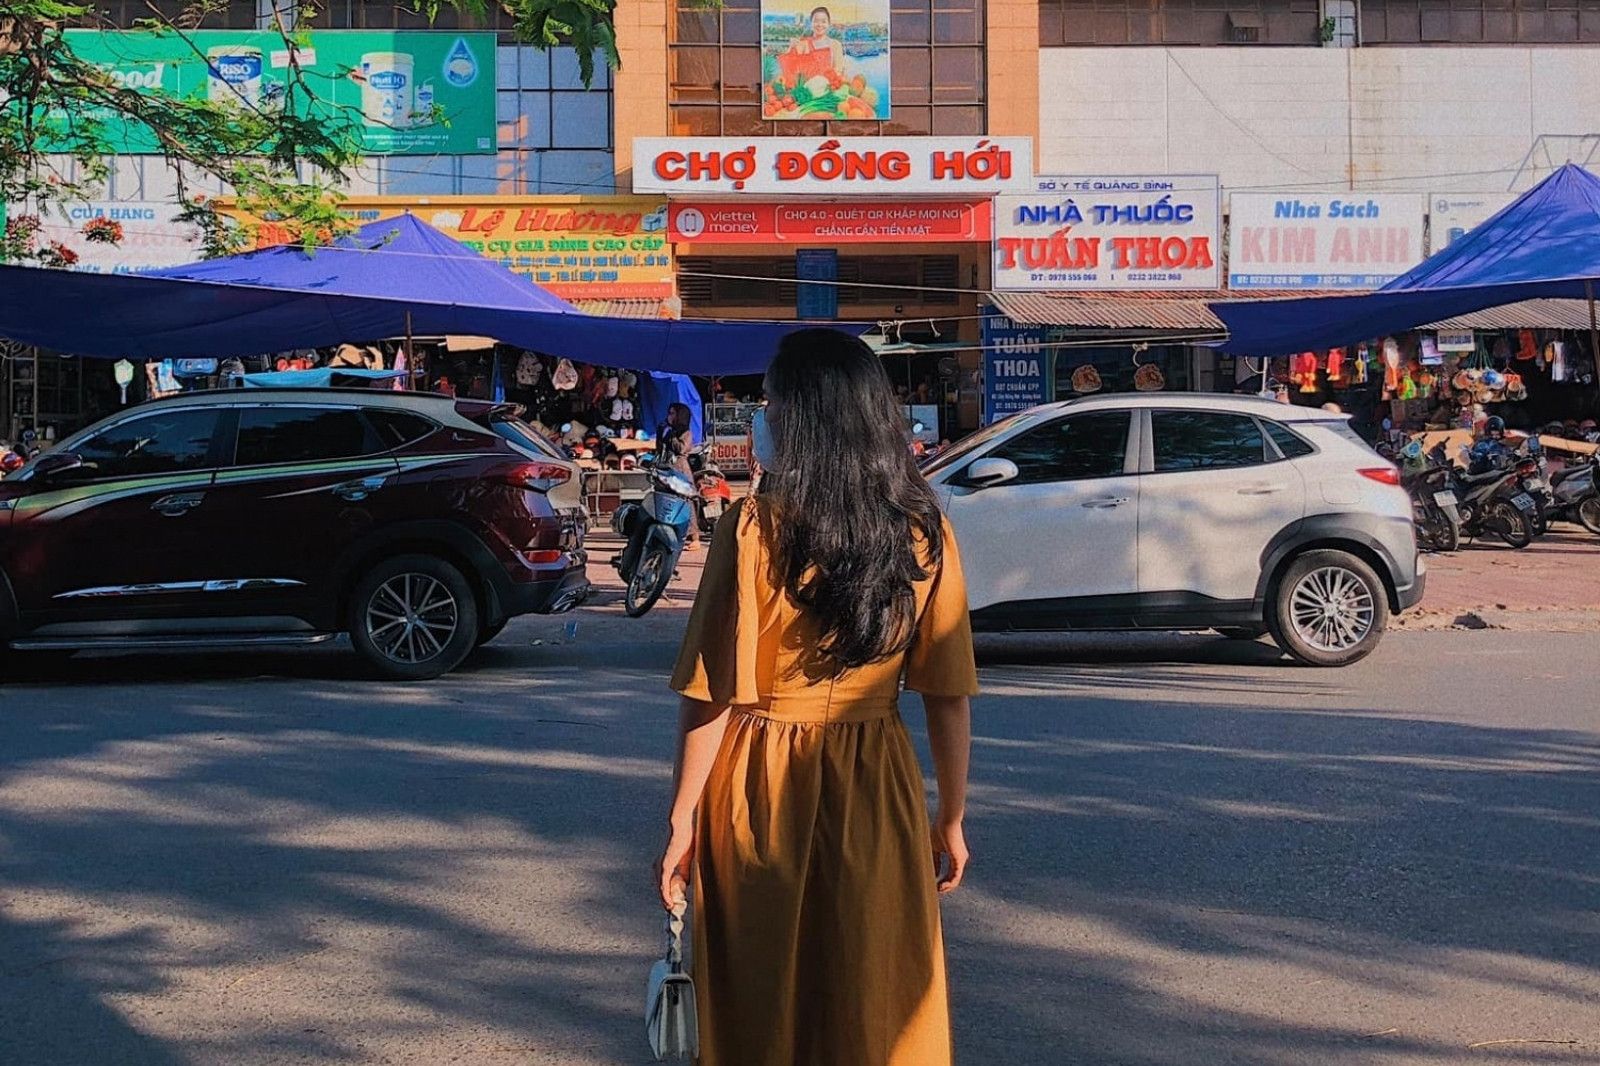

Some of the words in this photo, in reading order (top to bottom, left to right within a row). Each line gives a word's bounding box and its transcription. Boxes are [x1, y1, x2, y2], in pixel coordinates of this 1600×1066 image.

[655, 146, 756, 190] CHỢ
[776, 140, 911, 181] ĐỒNG
[932, 140, 1012, 181] HỚI
[1038, 180, 1056, 190] SỞ
[1060, 182, 1068, 190] Y
[1073, 179, 1091, 190] TẾ
[1143, 179, 1174, 190] BÌNH
[710, 210, 757, 223] viettel
[784, 210, 808, 221] CHỢ
[809, 211, 826, 219] 4.0
[835, 208, 865, 220] QUÉT
[868, 210, 883, 220] QR
[918, 209, 940, 221] MỌI
[1018, 198, 1083, 224] NHÀ
[1095, 195, 1194, 223] THUỐC
[1274, 200, 1321, 219] Nhà
[1328, 200, 1380, 219] Sách
[460, 207, 505, 238] Lệ
[515, 206, 642, 238] Hương
[709, 220, 759, 235] money
[593, 239, 626, 251] CAO
[999, 226, 1101, 270] TUẤN
[1108, 236, 1214, 270] THOA
[1241, 226, 1317, 264] KIM
[1329, 226, 1410, 264] ANH
[992, 333, 1040, 354] TUẤN
[993, 360, 1040, 377] THOA
